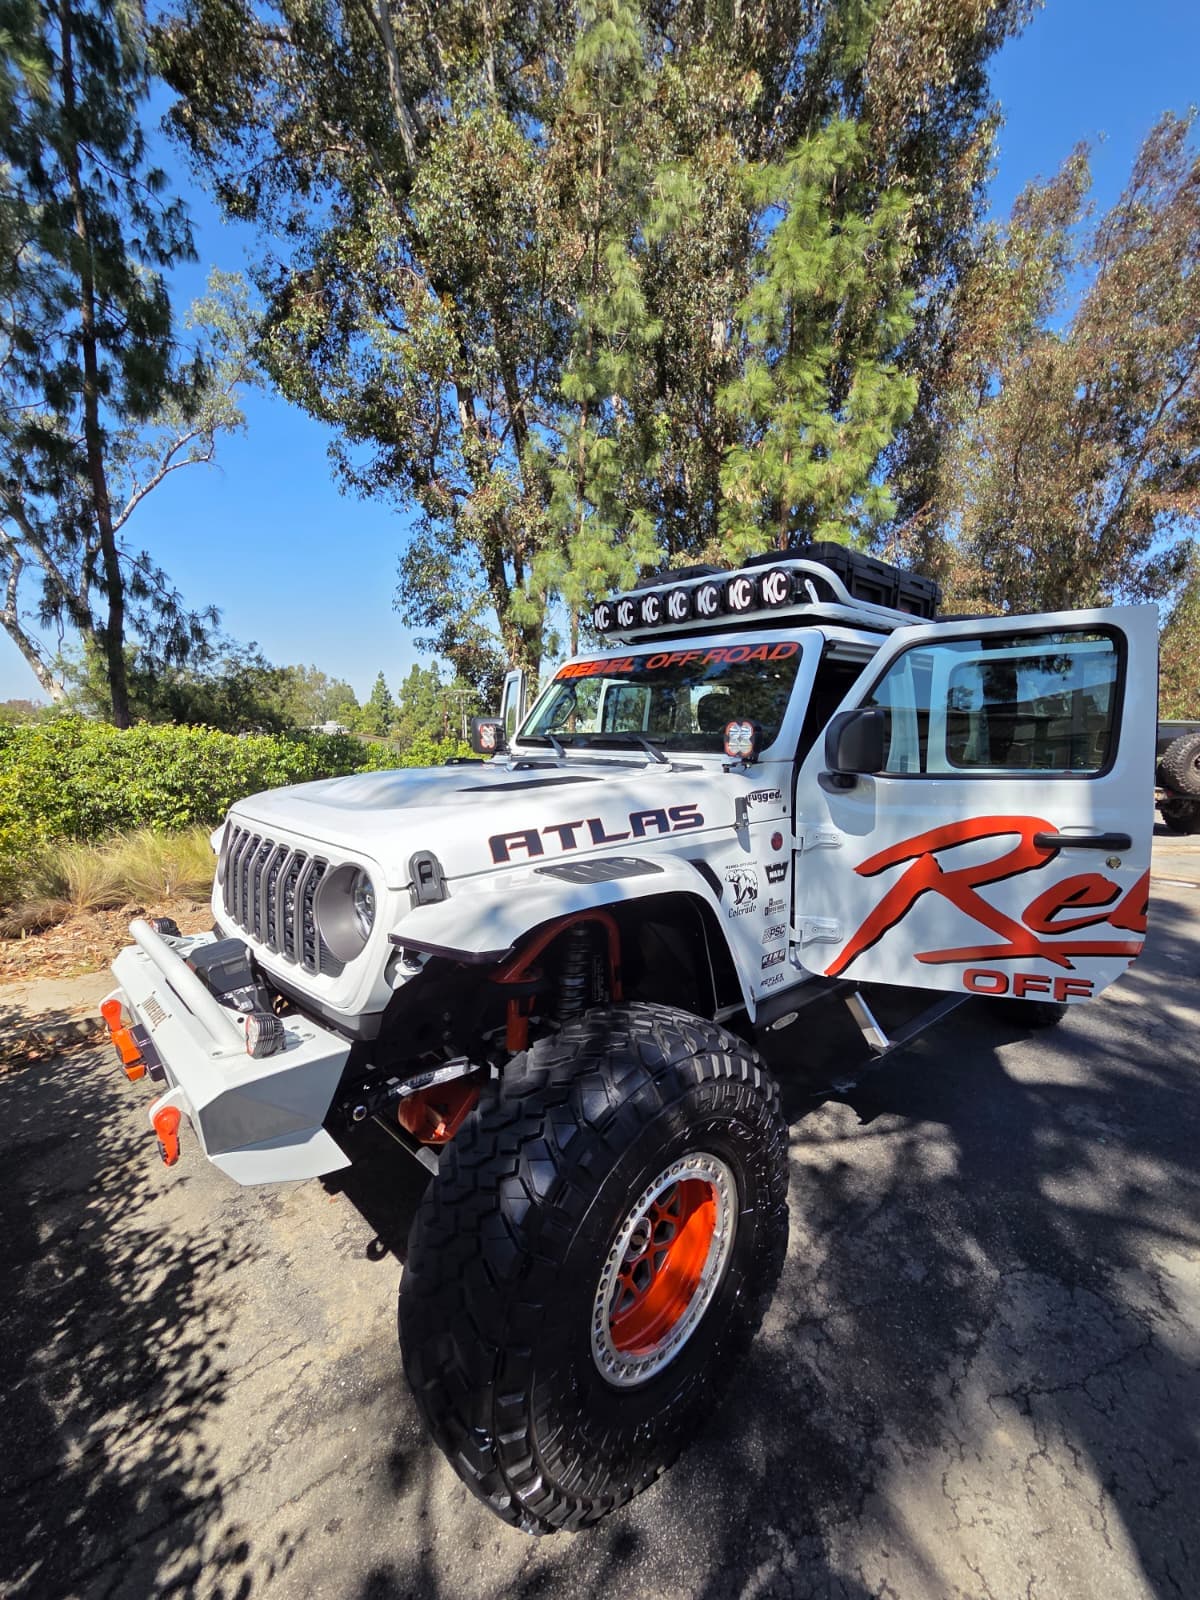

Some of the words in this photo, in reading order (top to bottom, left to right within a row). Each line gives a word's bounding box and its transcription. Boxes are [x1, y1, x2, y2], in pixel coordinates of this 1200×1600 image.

[697, 585, 717, 615] KC
[729, 578, 750, 610] KC
[762, 571, 787, 603] KC
[594, 606, 610, 630] KC
[617, 600, 634, 627] KC
[641, 596, 659, 623] KC
[668, 591, 687, 619] KC
[556, 656, 635, 680] REBEL
[646, 650, 704, 669] OFF
[700, 641, 799, 665] ROAD
[488, 803, 705, 864] ATLAS
[728, 902, 757, 918] Colorado
[962, 968, 1095, 1002] OFF
